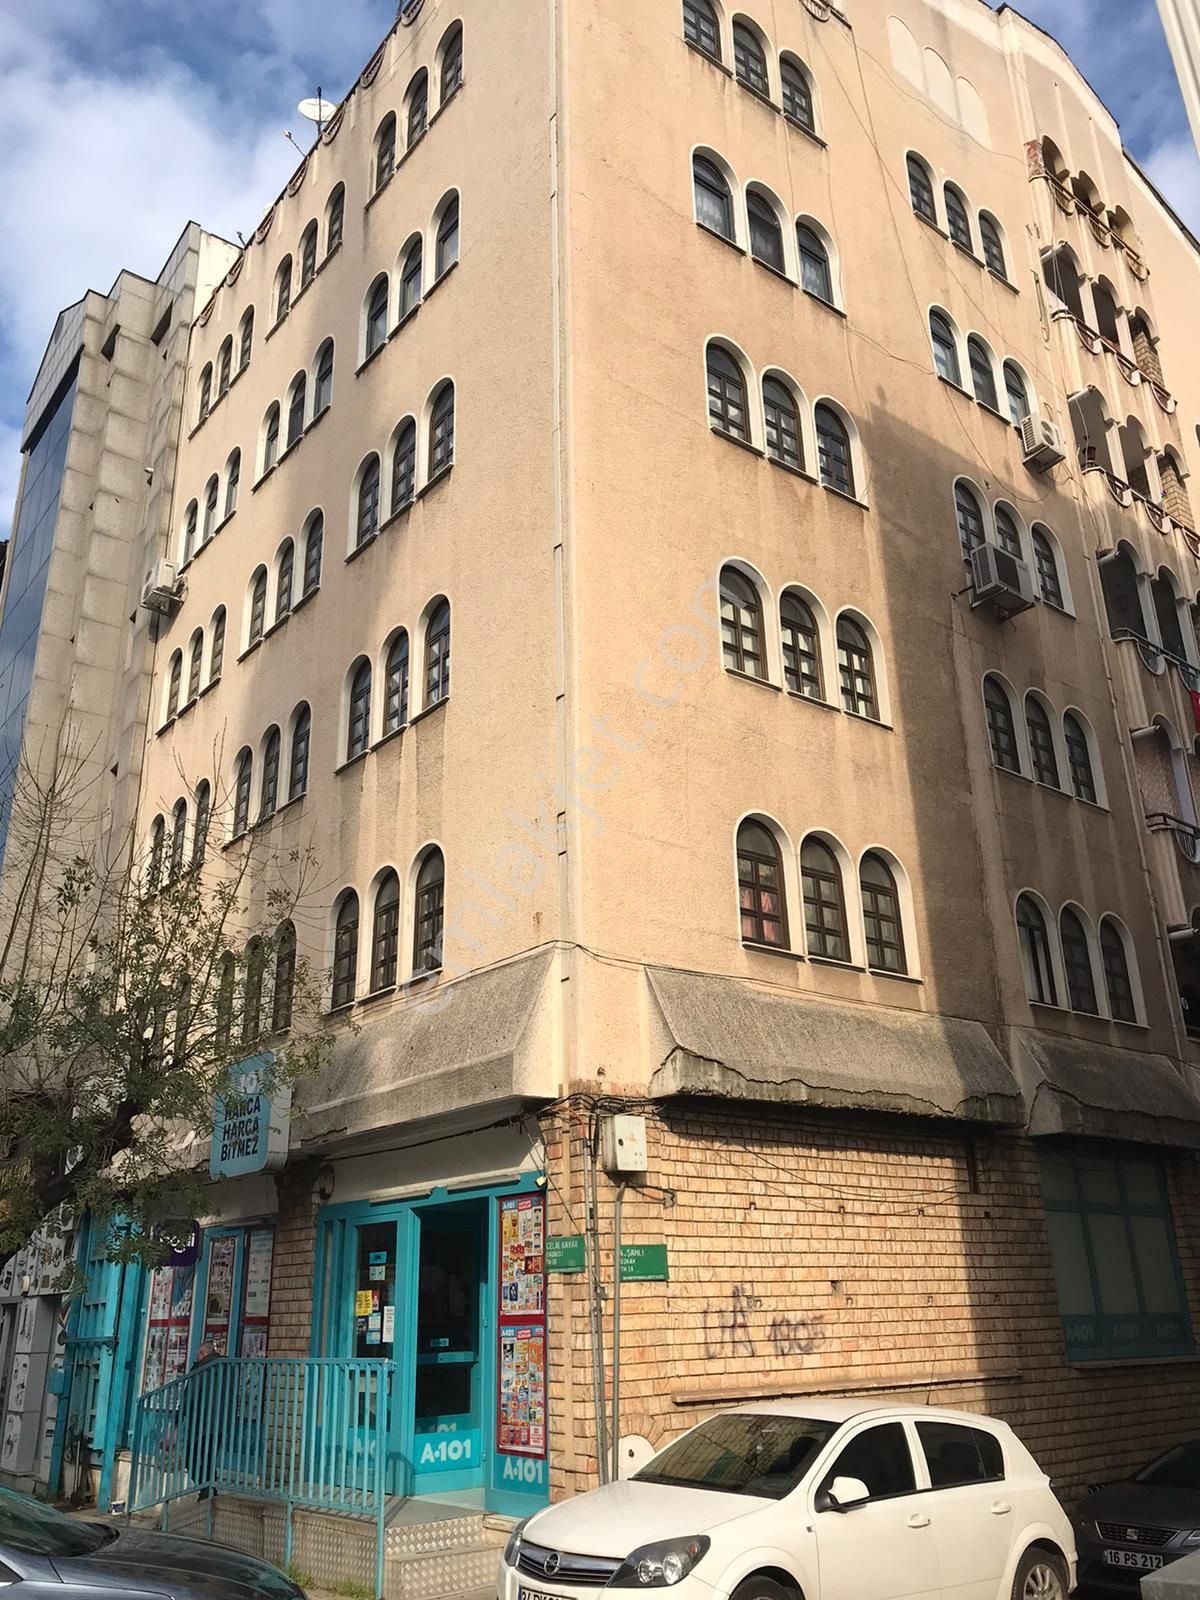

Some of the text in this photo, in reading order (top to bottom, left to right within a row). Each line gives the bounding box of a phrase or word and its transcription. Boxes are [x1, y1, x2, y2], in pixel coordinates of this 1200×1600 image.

[222, 1117, 259, 1141] HARCA
[1109, 1550, 1162, 1569] 16 PS 212
